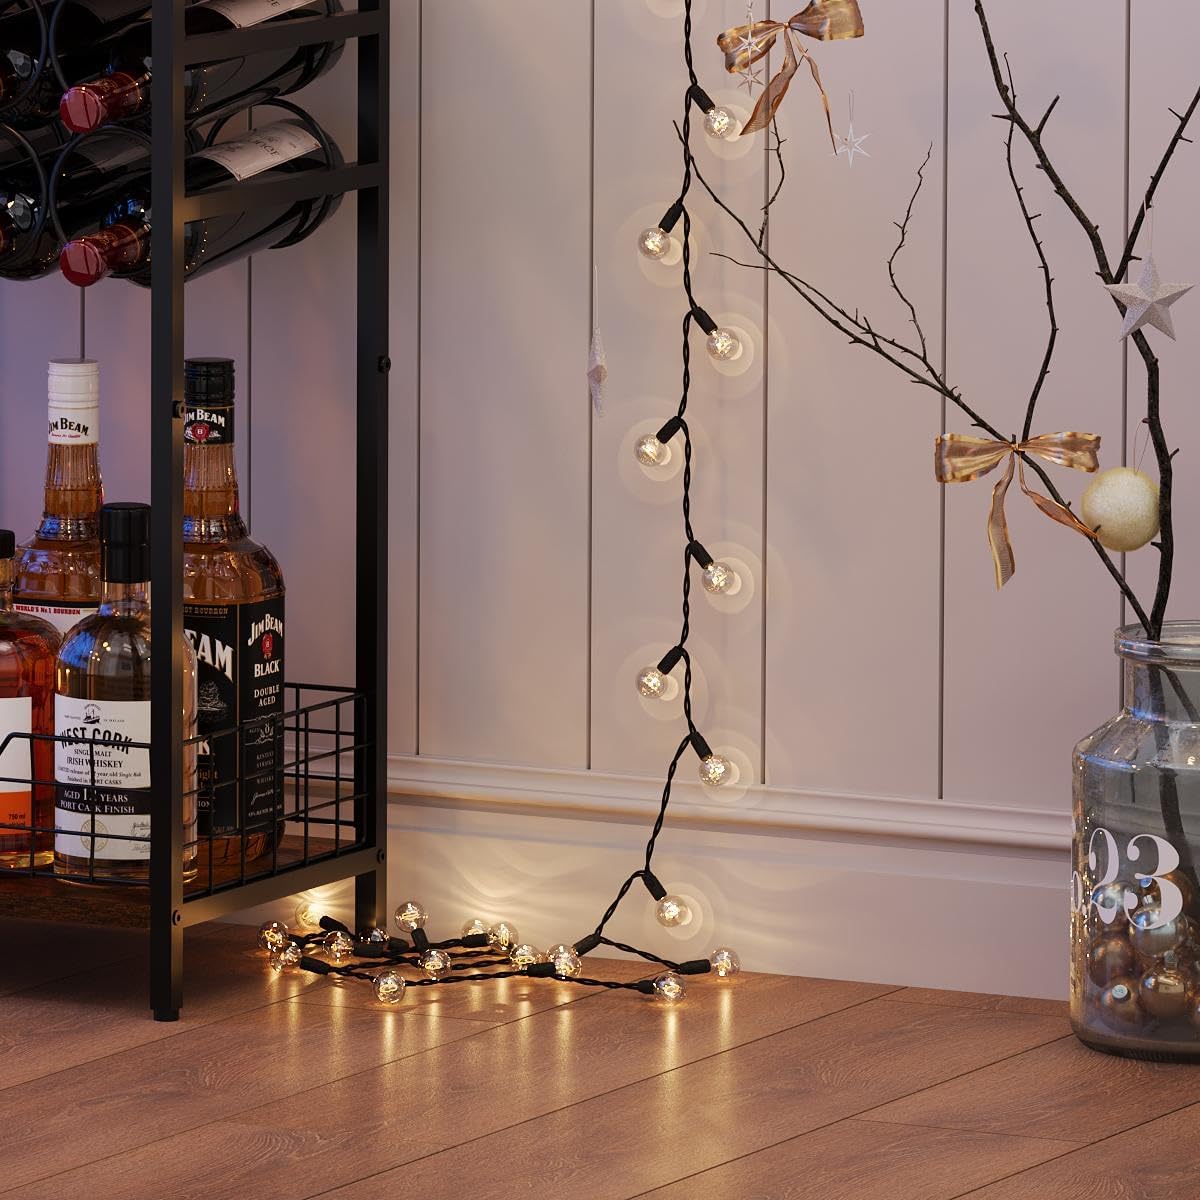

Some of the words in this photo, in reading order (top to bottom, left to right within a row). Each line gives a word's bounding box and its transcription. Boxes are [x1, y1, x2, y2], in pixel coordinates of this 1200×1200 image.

[196, 408, 225, 427] BEAM
[60, 417, 89, 437] BEAM
[53, 607, 81, 615] BOURBON
[248, 619, 265, 646] JIM
[265, 613, 283, 638] BEAM
[184, 628, 234, 682] EAM
[254, 659, 279, 678] BLACK
[254, 684, 280, 698] DOUBLE
[258, 696, 276, 707] AGED
[61, 727, 87, 749] WEST
[92, 727, 133, 755] CORK
[74, 748, 91, 757] SINGL
[67, 757, 83, 766] IRISH
[85, 759, 123, 768] WHISKEY
[64, 789, 80, 800] AGED
[100, 793, 128, 802] YEARS
[60, 800, 76, 810] PORT
[78, 802, 101, 813] CAK
[104, 804, 135, 814] FINISH
